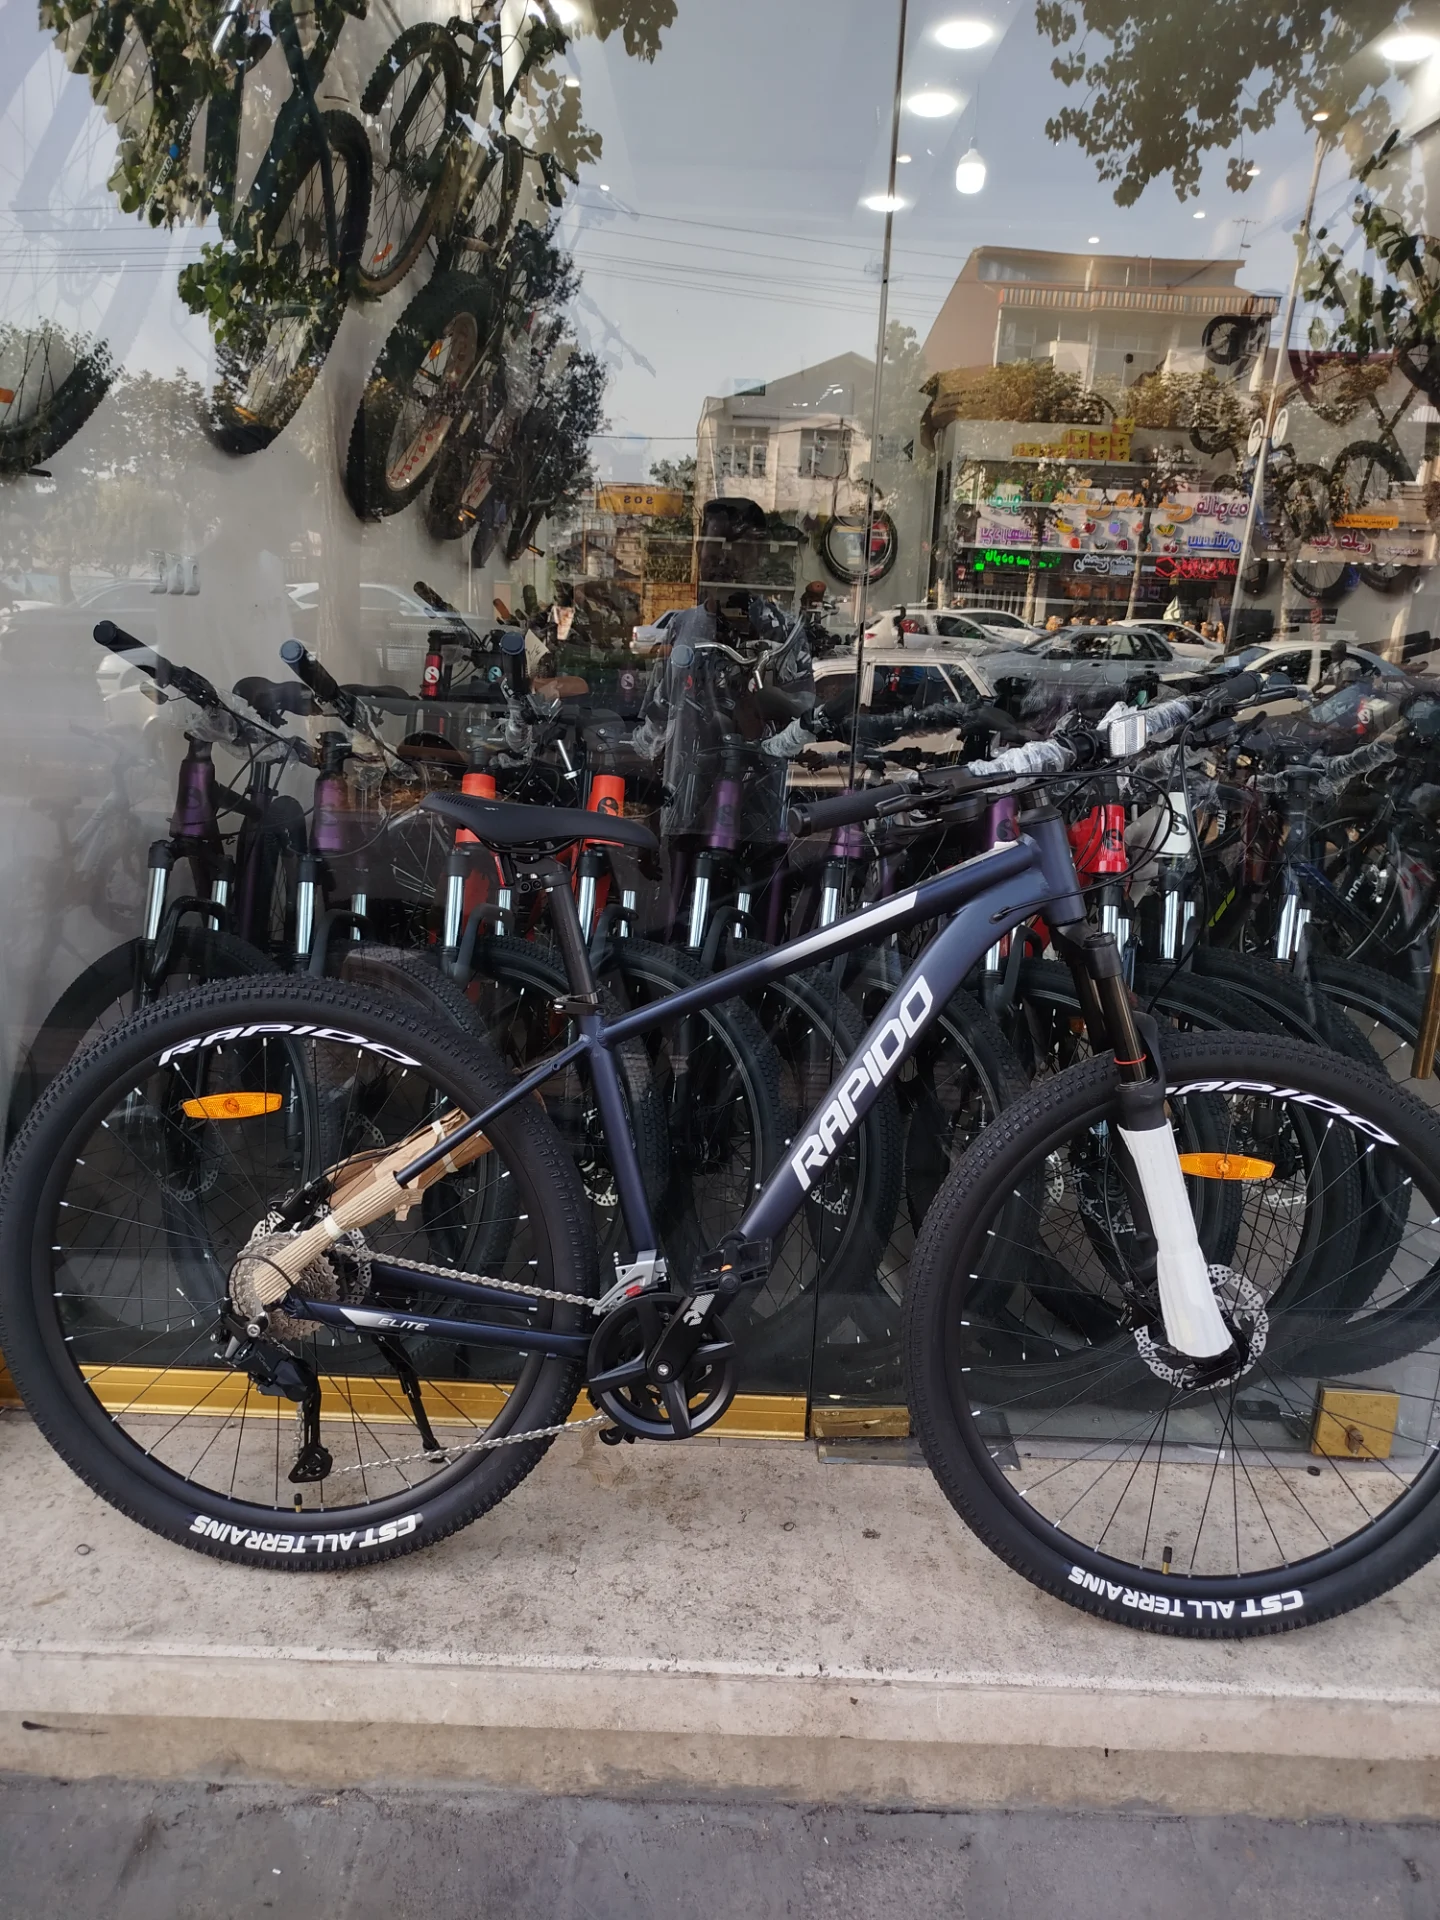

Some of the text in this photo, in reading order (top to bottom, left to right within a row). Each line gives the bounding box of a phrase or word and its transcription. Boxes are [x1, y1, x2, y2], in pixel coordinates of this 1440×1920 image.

[158, 1024, 422, 1066] RAPIDO
[789, 973, 934, 1190] RAPIDO
[1165, 1081, 1400, 1146] APIDO
[378, 1317, 430, 1331] ELITE
[189, 1513, 418, 1554] CST ALL TERRAINS
[1067, 1565, 1304, 1619] CST ALL TERRAINS
